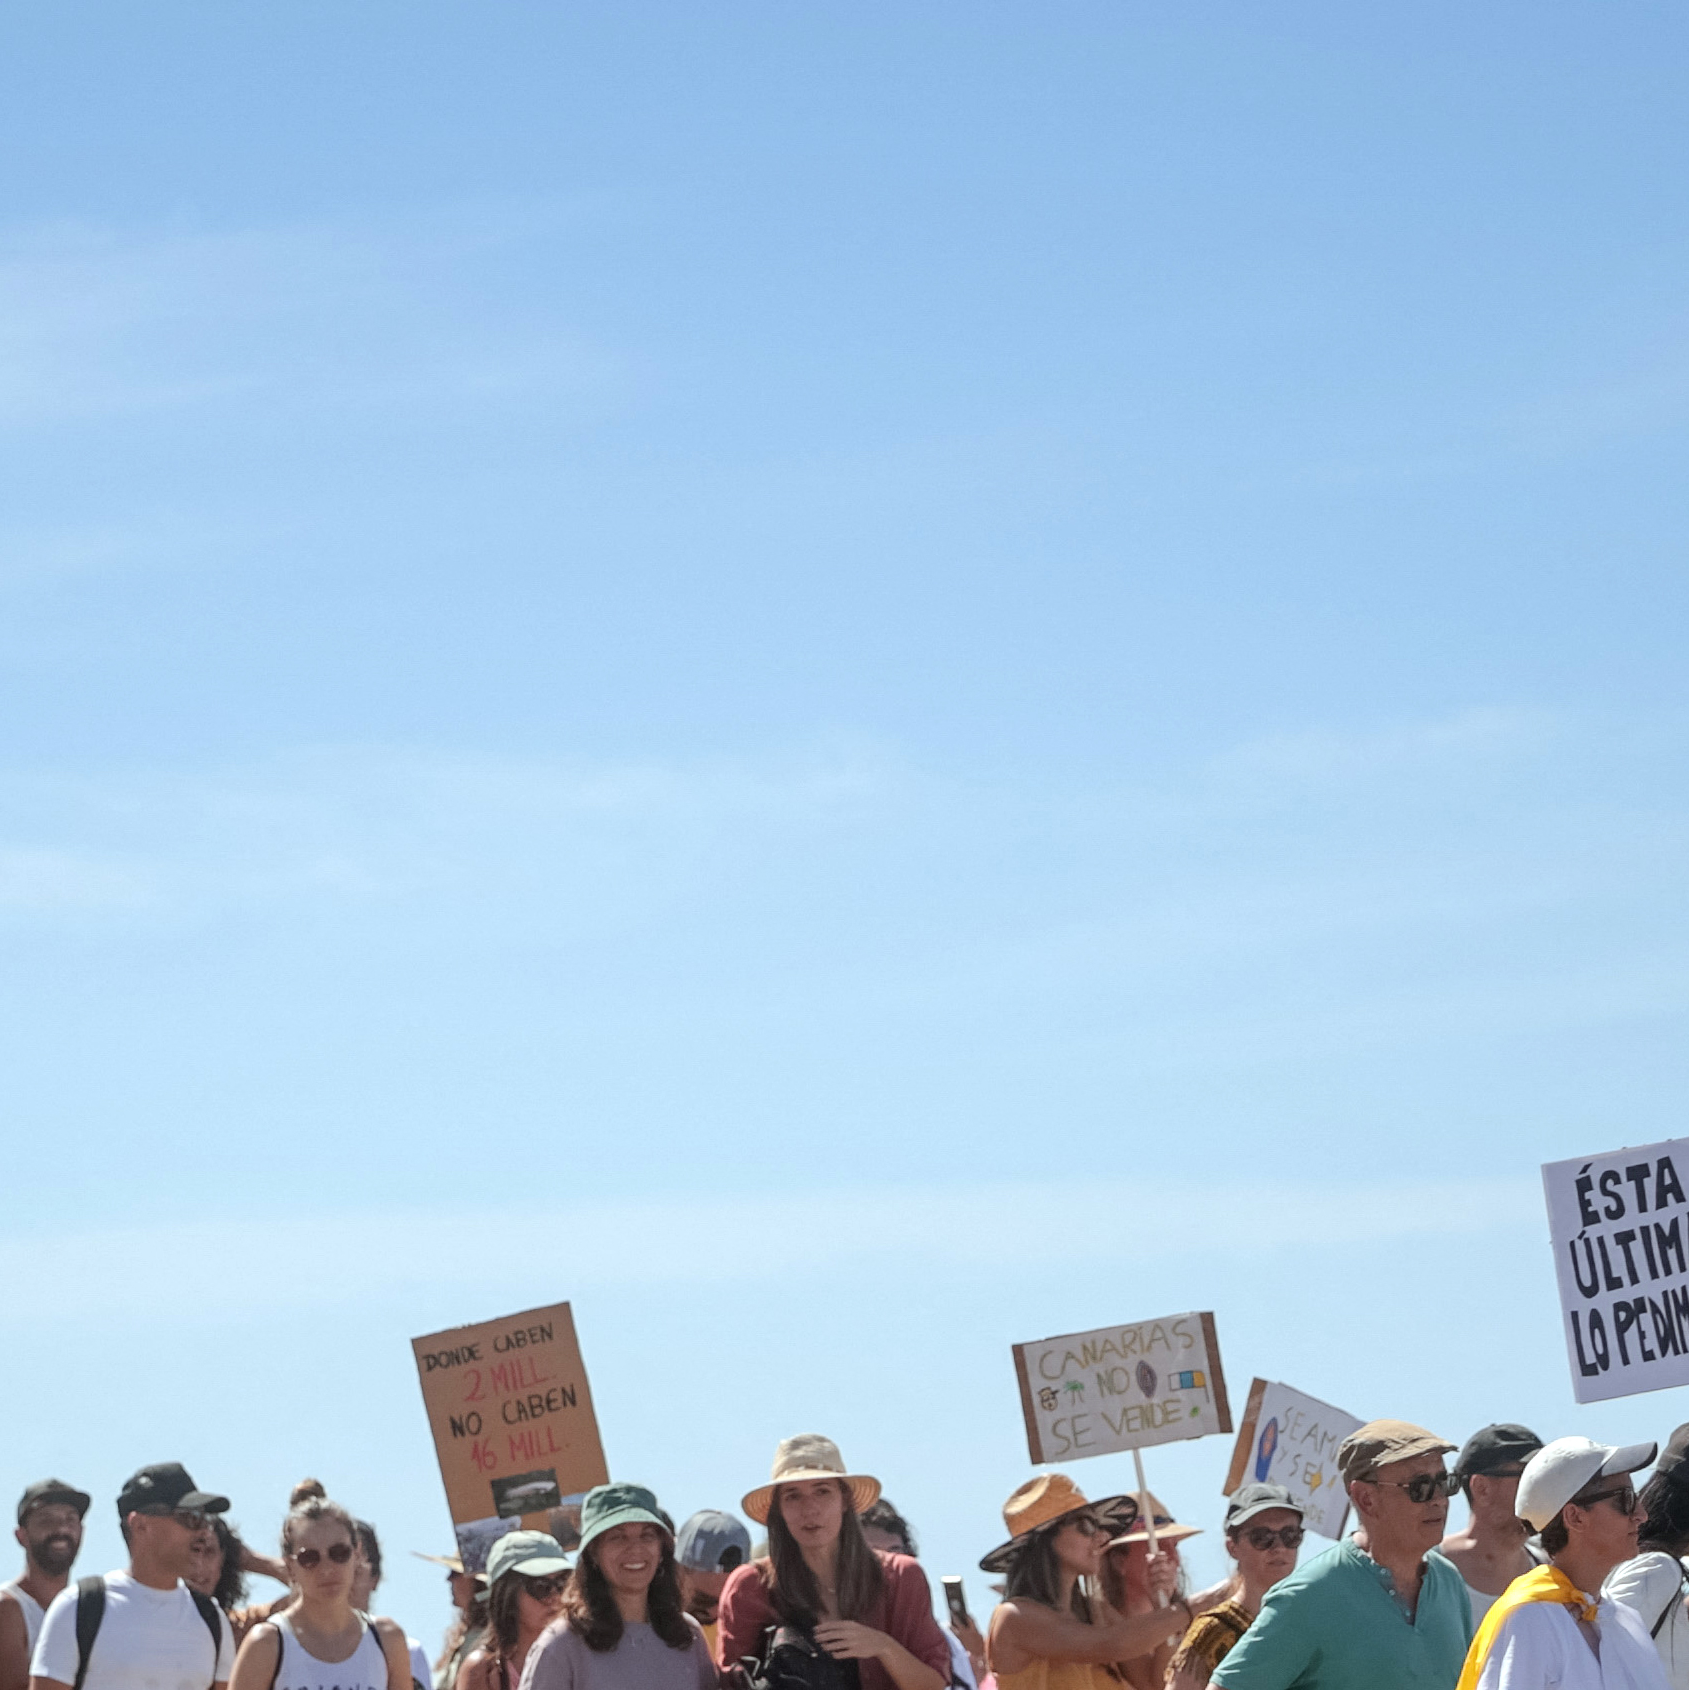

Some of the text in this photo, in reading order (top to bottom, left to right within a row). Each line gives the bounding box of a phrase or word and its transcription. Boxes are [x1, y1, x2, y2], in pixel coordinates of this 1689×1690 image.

[1575, 1162, 1686, 1228] ÉSTA
[422, 1322, 554, 1372] DONDE CABEN
[1570, 1307, 1611, 1377] LO
[464, 1356, 558, 1402] 2 MILL.
[1096, 1366, 1130, 1398] NO
[449, 1383, 577, 1439] NO CABEN
[1051, 1399, 1183, 1455] SE VENDE
[471, 1437, 498, 1473] 16
